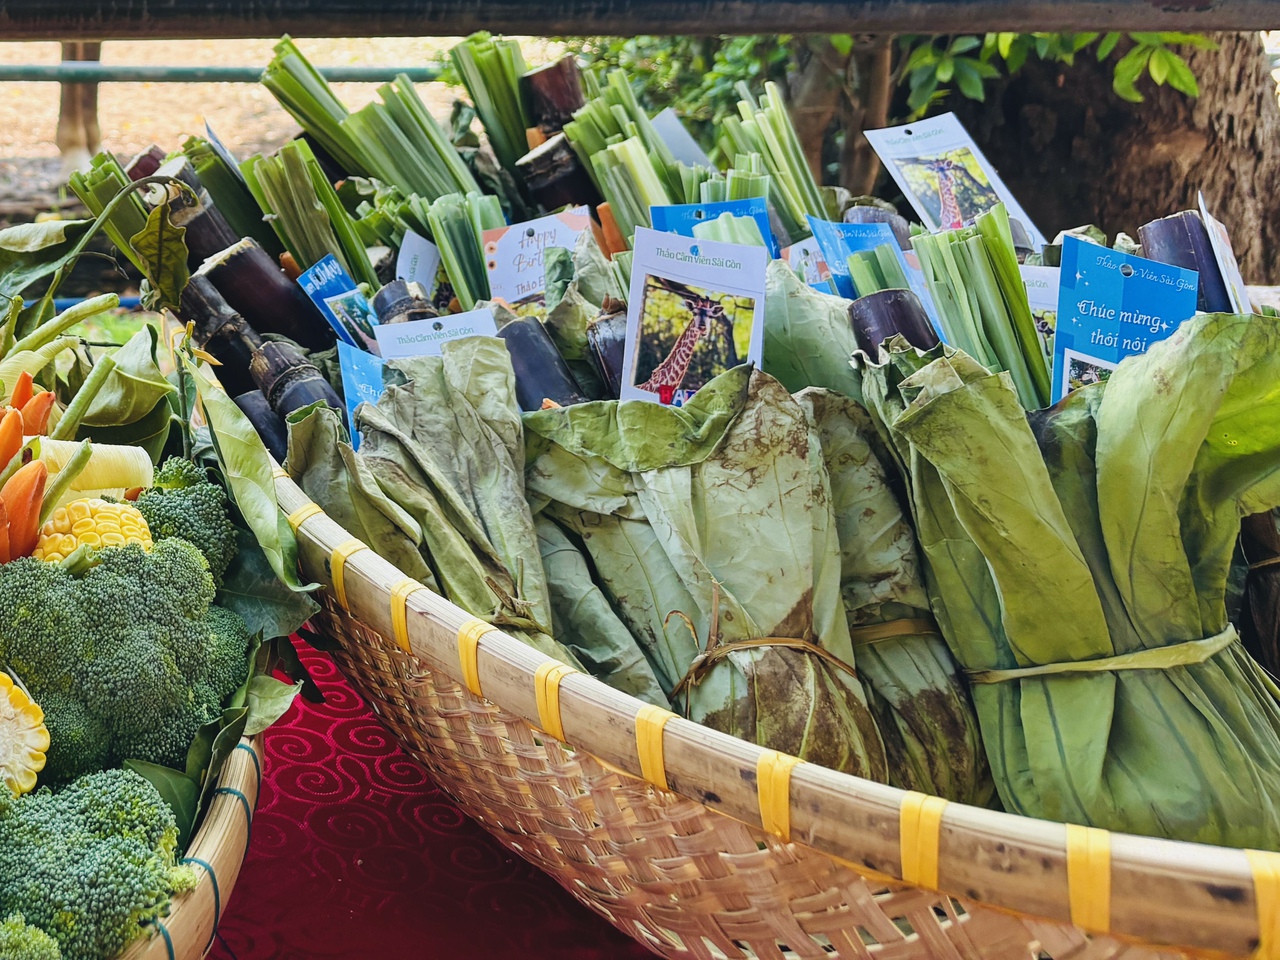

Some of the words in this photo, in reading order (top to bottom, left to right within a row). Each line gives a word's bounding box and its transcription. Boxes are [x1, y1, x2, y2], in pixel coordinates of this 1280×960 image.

[512, 248, 544, 272] Birt
[656, 247, 674, 259] Thảo
[1077, 300, 1115, 320] Chúc
[1119, 310, 1161, 333] mừng
[1090, 329, 1119, 348] thôi
[1122, 338, 1147, 352] nôi
